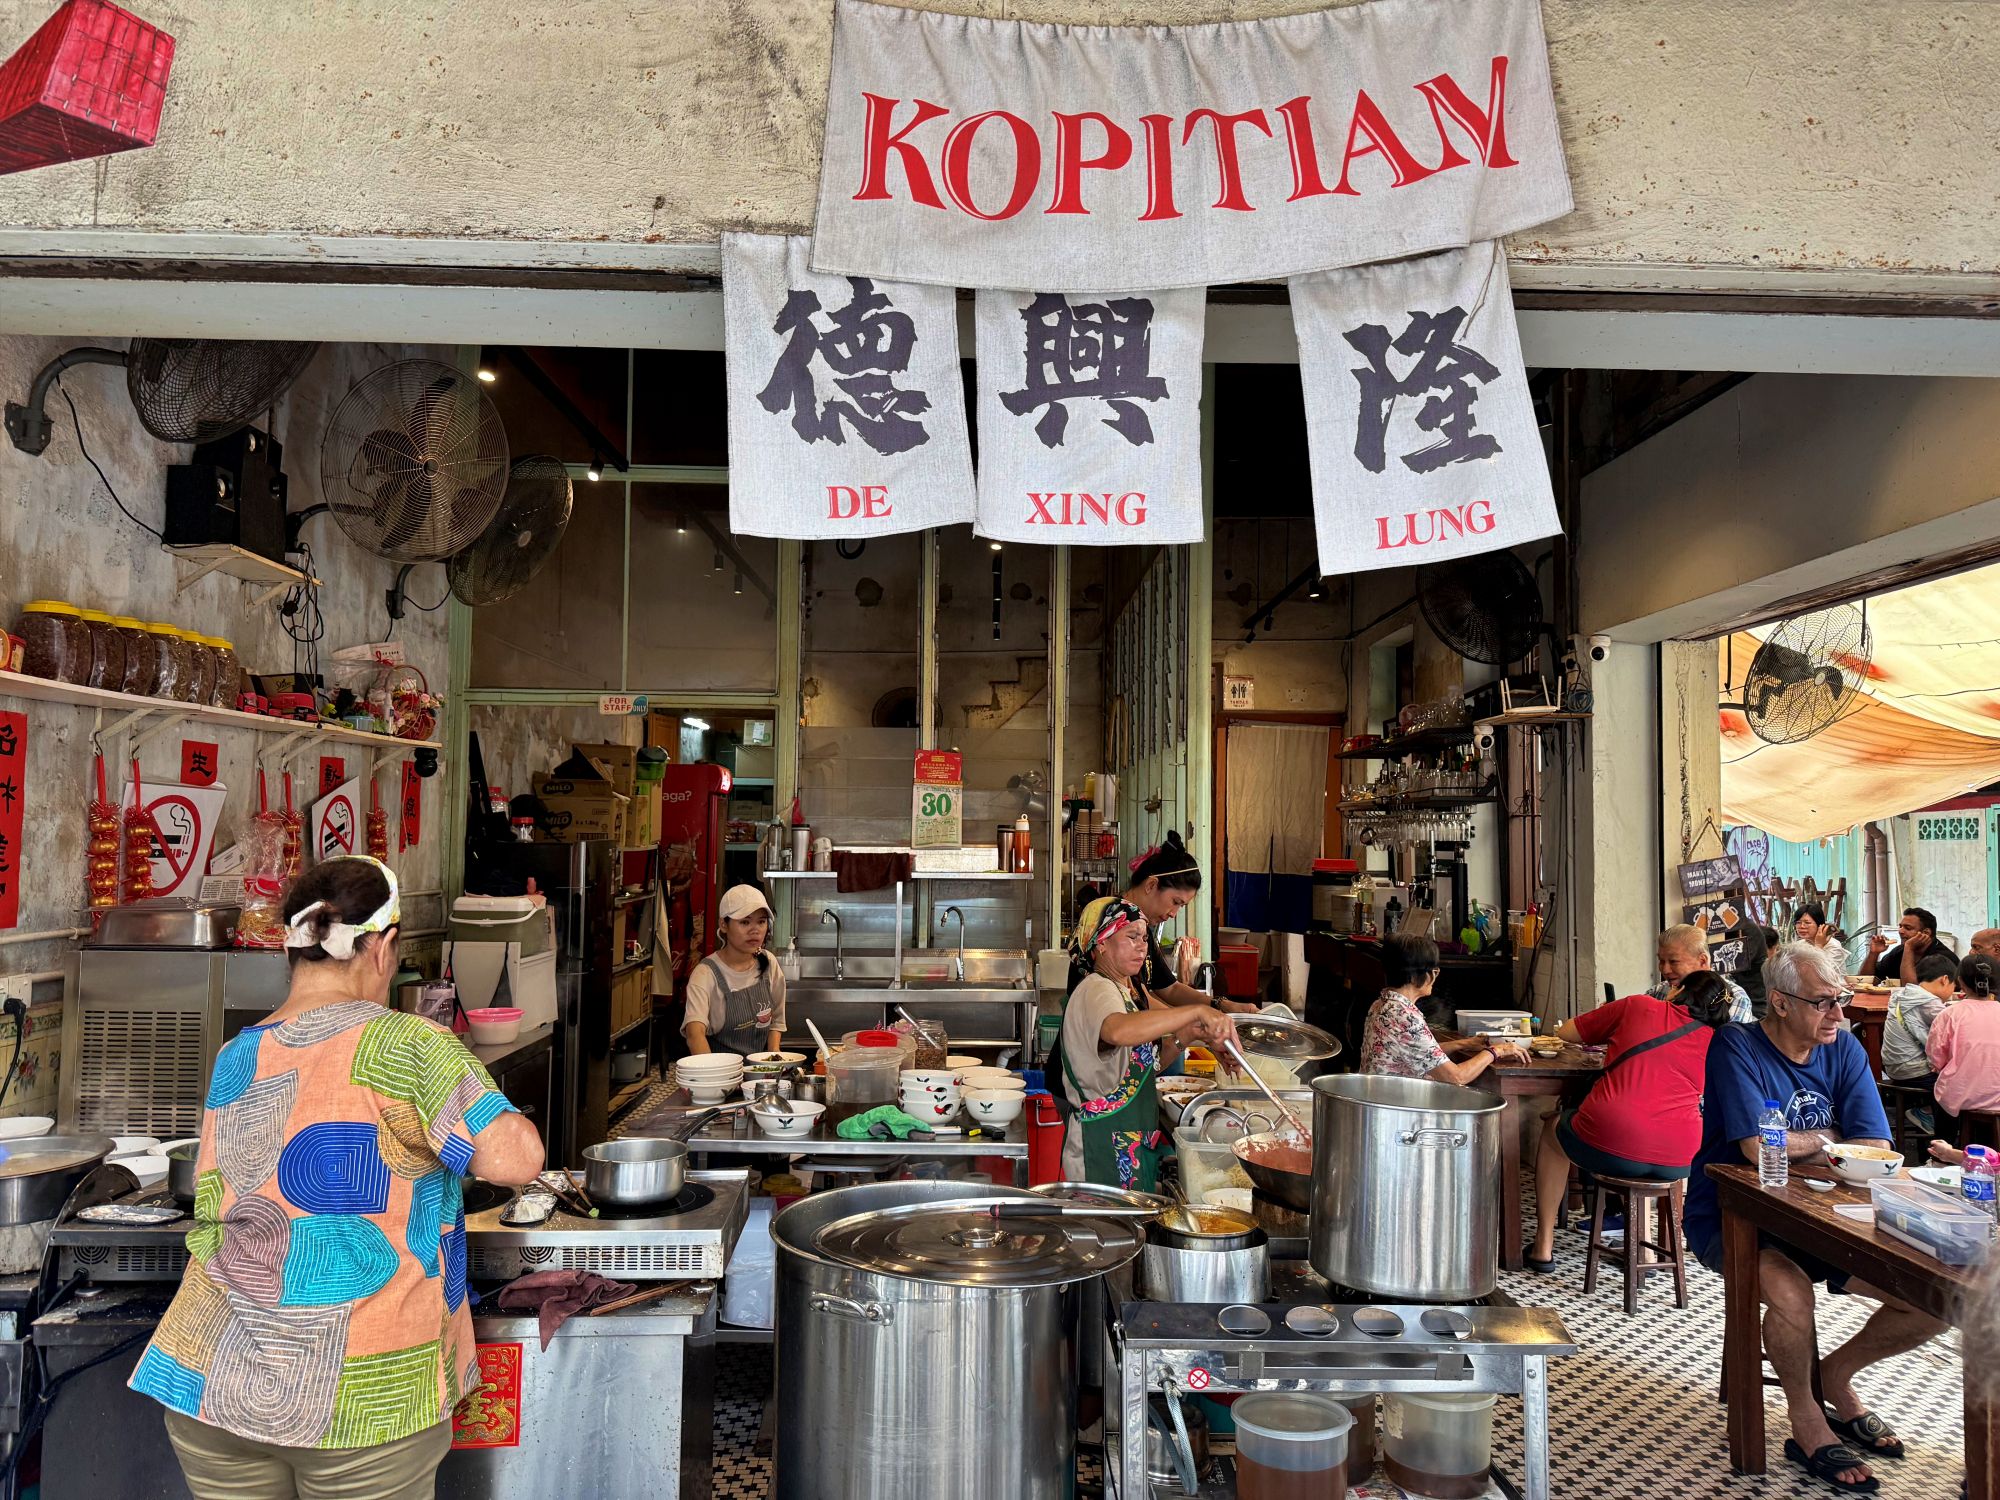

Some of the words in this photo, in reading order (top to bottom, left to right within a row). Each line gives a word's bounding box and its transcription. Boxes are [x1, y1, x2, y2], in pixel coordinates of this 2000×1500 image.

[853, 56, 1519, 220] KOPITIAM
[756, 276, 932, 456] 德
[1000, 292, 1169, 449] 興
[1342, 306, 1502, 474] 隆
[828, 486, 892, 518] DE
[1026, 492, 1146, 525] XING
[1376, 500, 1496, 549] LUNG
[922, 792, 952, 817] 30
